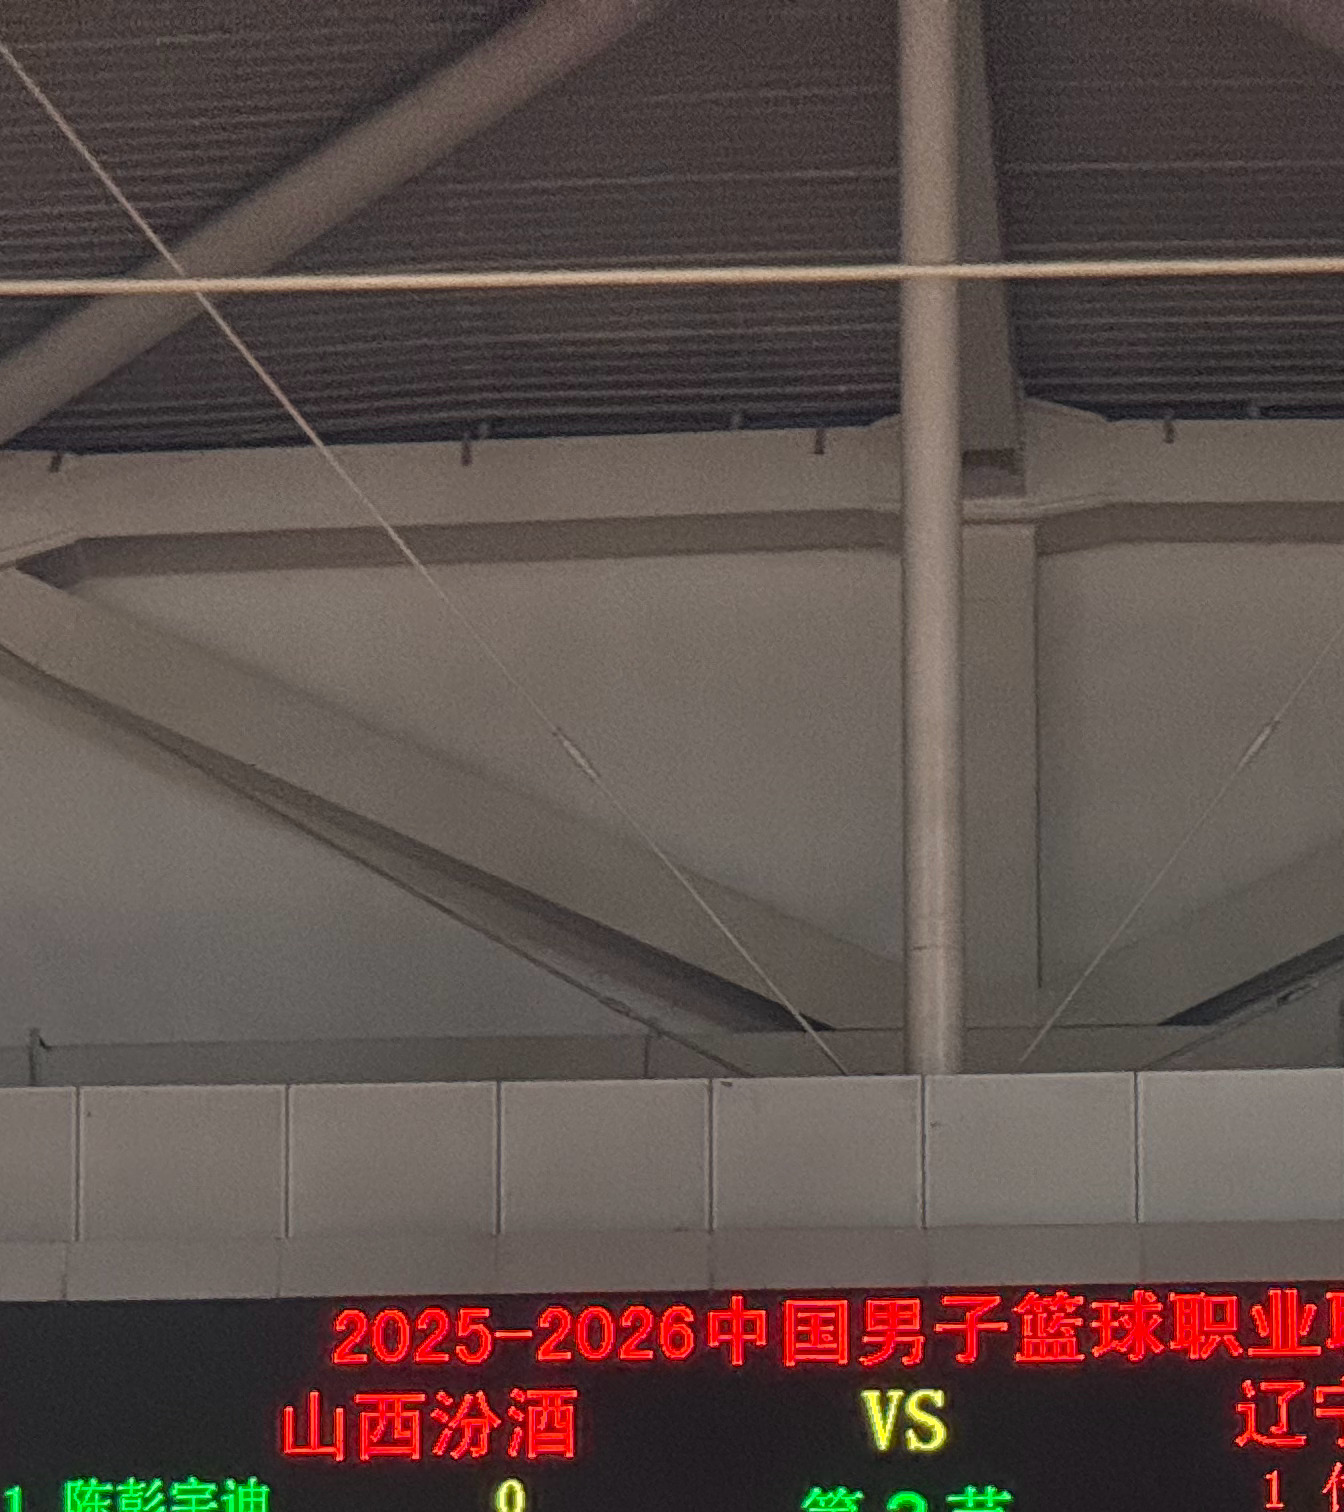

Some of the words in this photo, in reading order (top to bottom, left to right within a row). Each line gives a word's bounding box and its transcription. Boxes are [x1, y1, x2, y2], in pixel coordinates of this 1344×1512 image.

[282, 1388, 578, 1461] 山西汾酒
[862, 1389, 946, 1451] VS
[1266, 1470, 1283, 1509] 1
